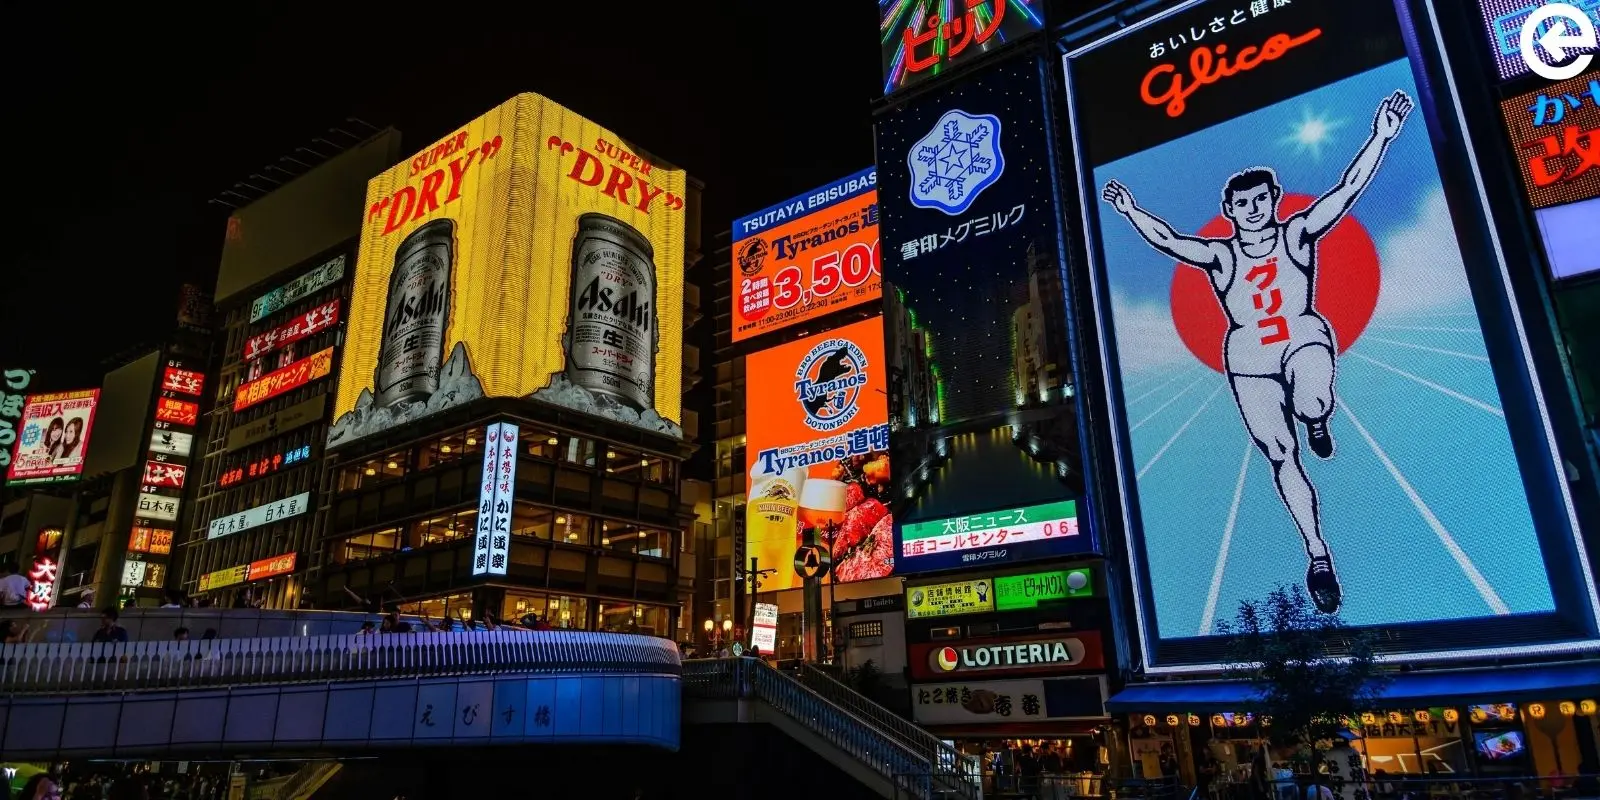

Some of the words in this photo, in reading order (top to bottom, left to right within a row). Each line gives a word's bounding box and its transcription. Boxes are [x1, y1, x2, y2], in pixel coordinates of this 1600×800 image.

[1141, 28, 1321, 117] Glico
[409, 130, 469, 177] SUPER
[595, 138, 652, 176] SUPER
[743, 201, 804, 232] TSUTAYA
[808, 172, 877, 208] EBISUBAS
[772, 220, 859, 260] Tyranos
[900, 203, 1026, 260] 雪印メグミルク
[388, 280, 444, 338] Asahi
[578, 276, 648, 332] Asahi
[1245, 256, 1291, 346] グリコ
[403, 335, 420, 353] 生
[592, 347, 633, 365] スーパードライ
[603, 330, 624, 349] 生
[797, 356, 811, 376] BBQ
[811, 340, 836, 357] BEER
[837, 339, 867, 367] GARDEN
[796, 373, 867, 400] Tyranos
[805, 406, 858, 430] DOTONBORI
[485, 446, 496, 494] 本場の味
[500, 446, 512, 494] 本場の味
[760, 442, 846, 475] Tyranos
[140, 497, 175, 514] 白木屋
[218, 514, 246, 535] 白木屋
[265, 499, 297, 522] 白木屋
[942, 509, 1028, 534] 大阪ニュース
[491, 499, 509, 569] かに道楽
[735, 518, 743, 580] TSUTAYA
[962, 549, 1007, 562] 雪印メグミルク
[1024, 575, 1065, 598] ピタットハウス
[963, 643, 1070, 666] LOTTERIA
[918, 686, 972, 704] たこ焼き
[420, 705, 551, 728] えびす橋
